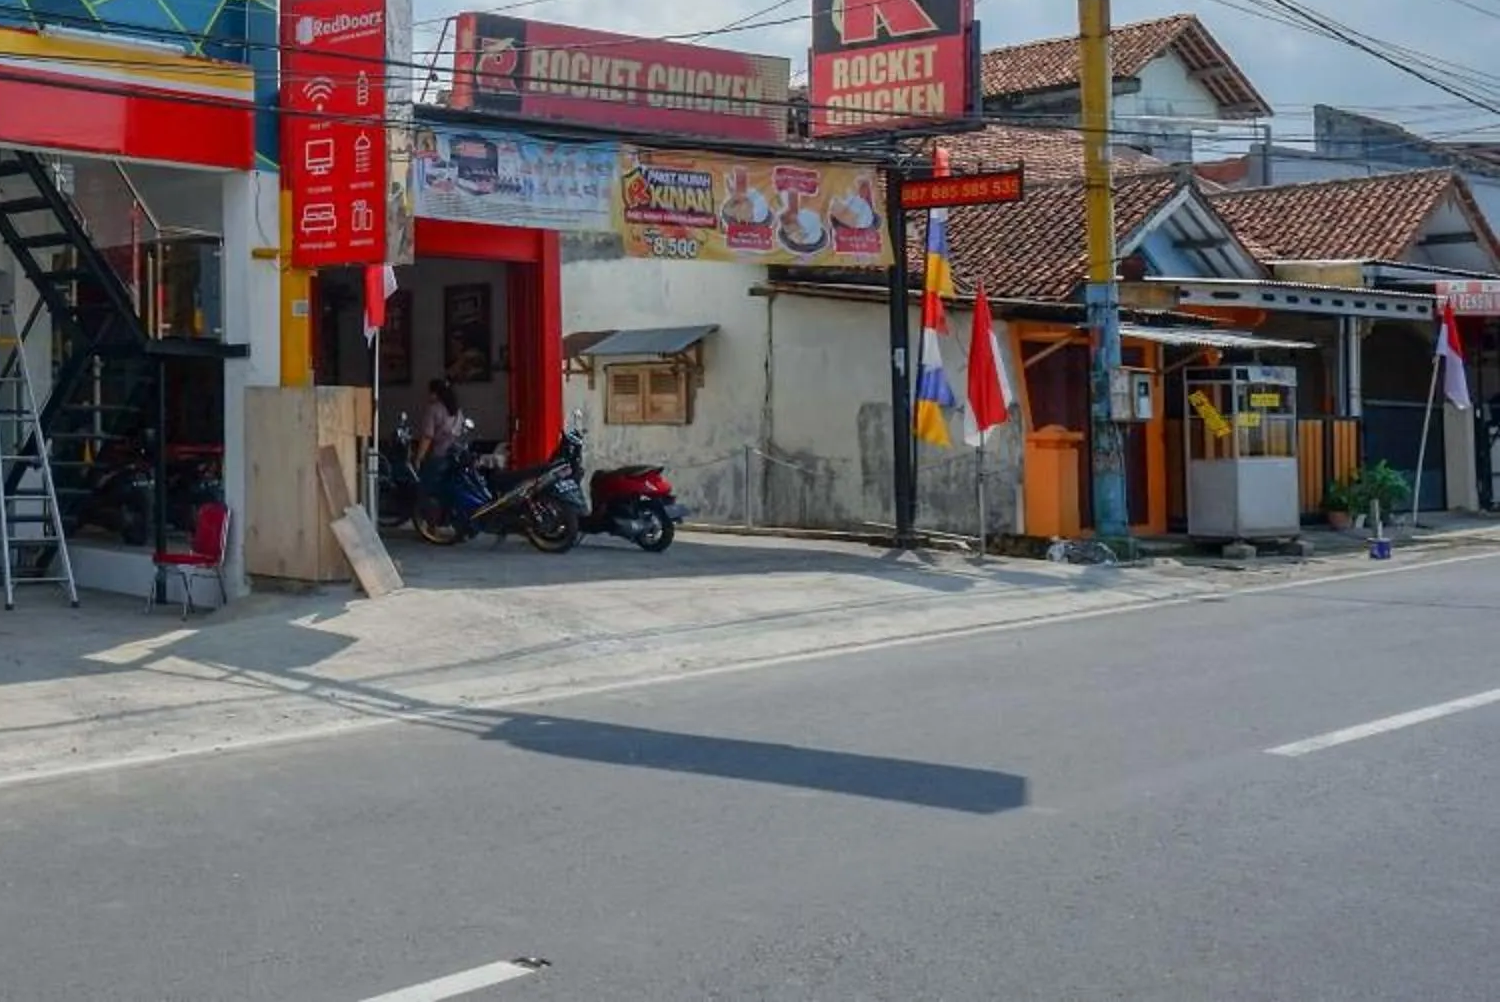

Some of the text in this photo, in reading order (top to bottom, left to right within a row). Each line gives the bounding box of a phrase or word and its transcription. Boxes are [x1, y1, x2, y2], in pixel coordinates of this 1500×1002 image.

[313, 10, 384, 37] RedDoorz
[530, 49, 764, 117] ROCKET CHICKEN
[833, 44, 938, 90] ROCKET
[825, 81, 946, 126] CHICKEN
